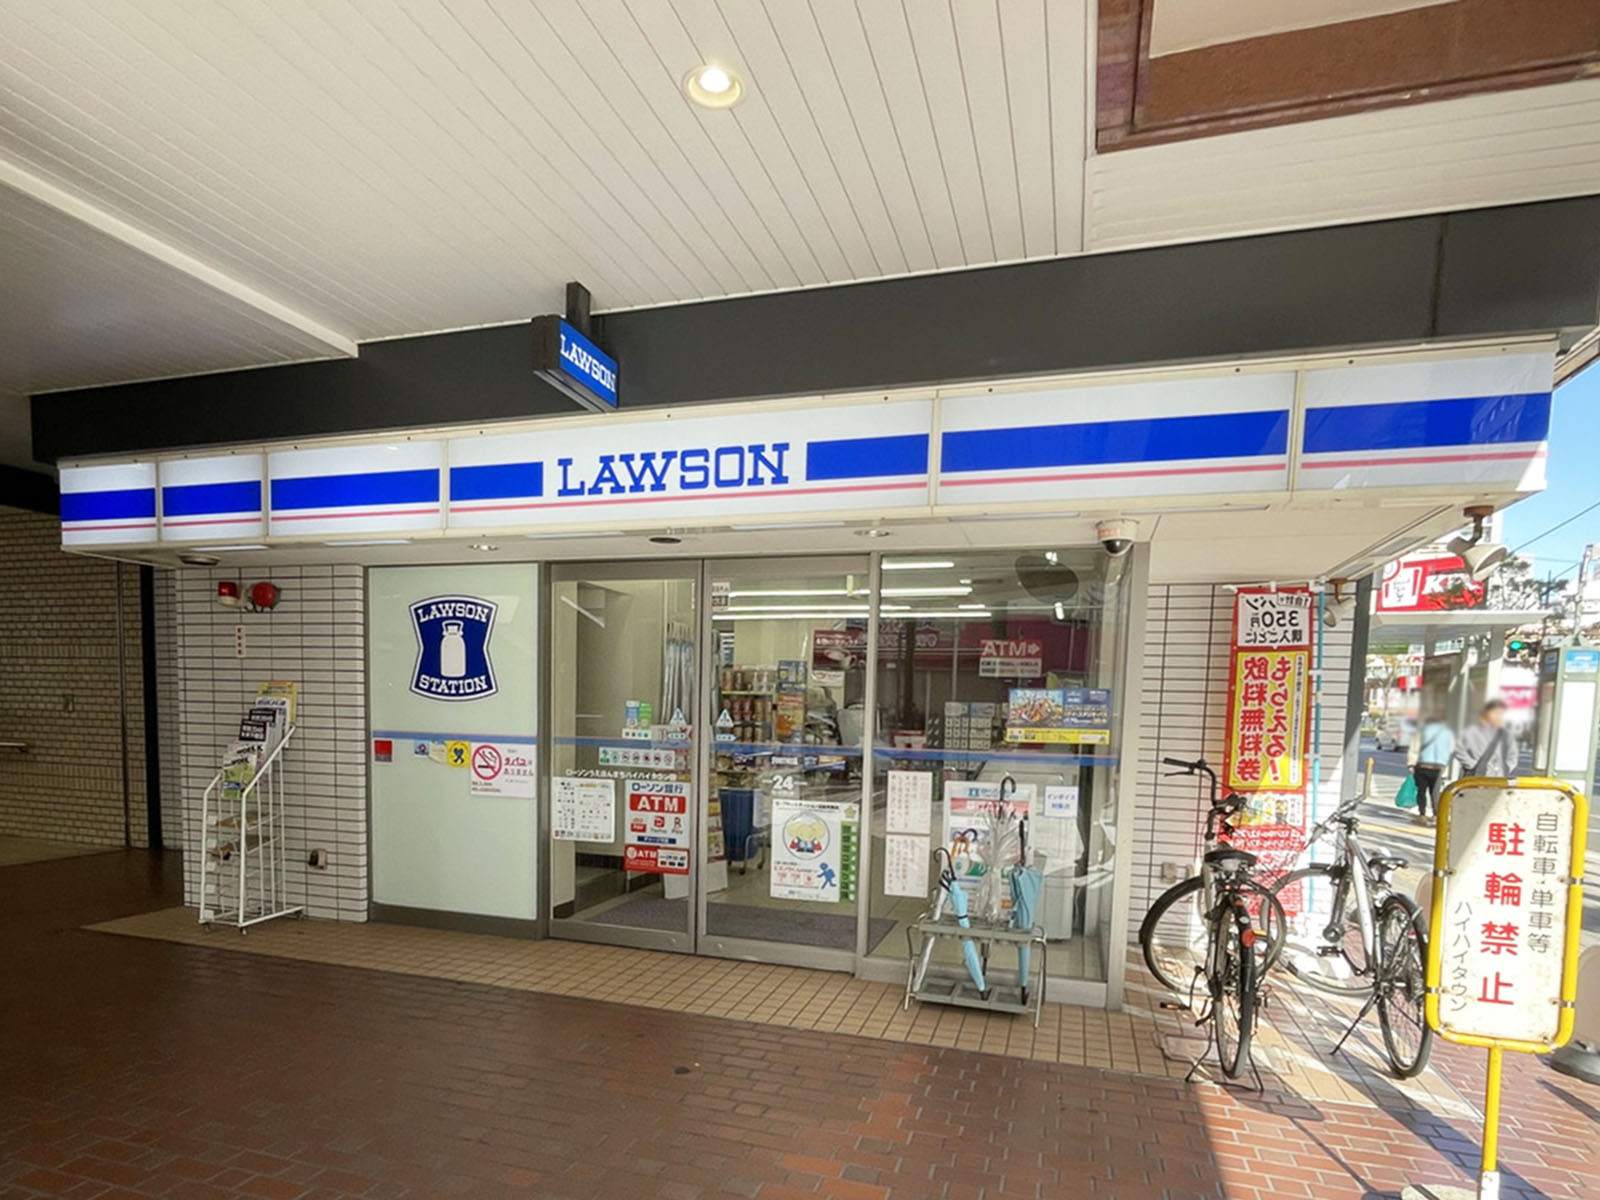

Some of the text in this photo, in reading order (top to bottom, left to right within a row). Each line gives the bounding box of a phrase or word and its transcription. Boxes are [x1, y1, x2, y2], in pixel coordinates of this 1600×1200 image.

[560, 334, 616, 393] LAWSON
[558, 443, 789, 497] LAWSON
[417, 603, 488, 623] LAWSON
[982, 641, 1027, 656] ATM
[419, 675, 488, 694] STATION
[632, 783, 683, 794] ローソン銀行
[773, 775, 794, 790] 24
[637, 796, 679, 812] ATM
[637, 850, 657, 859] ATM
[1477, 822, 1526, 1006] 駐輪禁止
[1450, 901, 1473, 1012] ハイハイタウン
